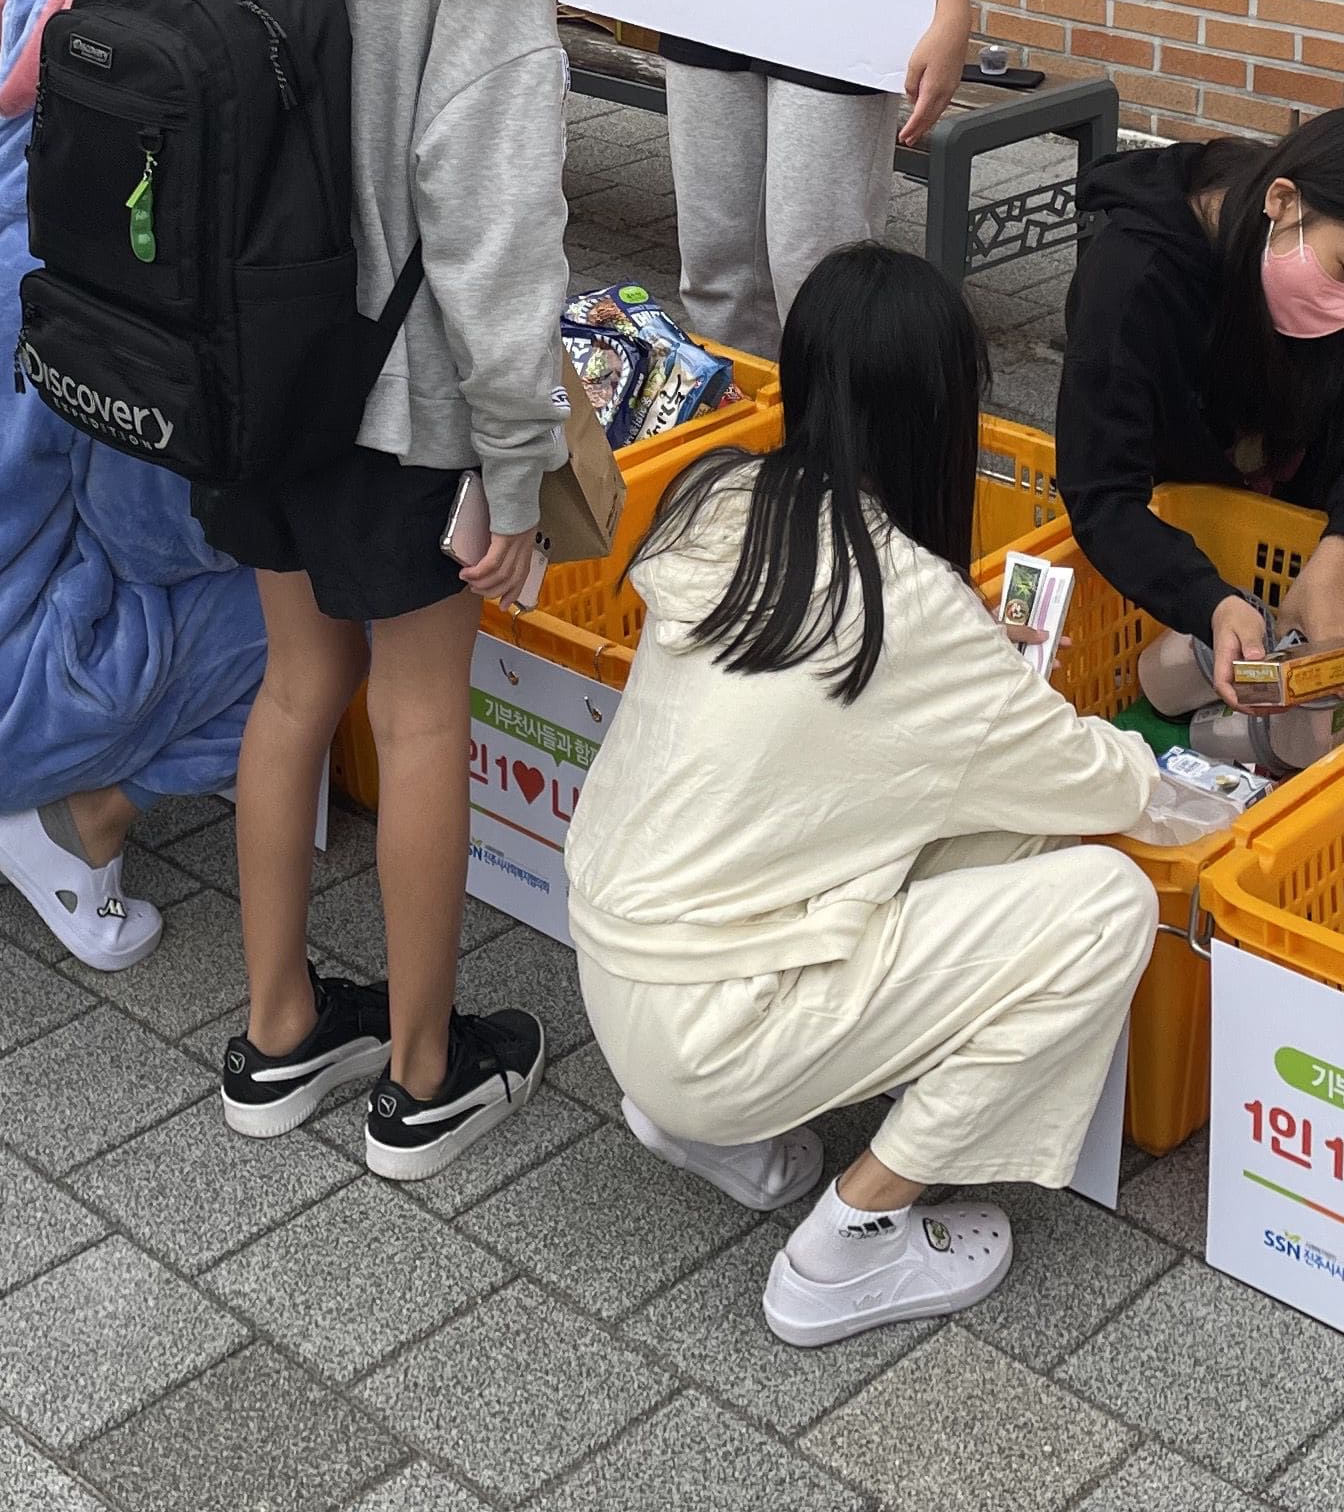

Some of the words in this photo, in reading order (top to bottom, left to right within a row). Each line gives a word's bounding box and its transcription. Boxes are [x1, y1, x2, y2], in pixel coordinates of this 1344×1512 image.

[484, 699, 572, 757] 기부천사들과
[1244, 1100, 1312, 1169] 1인
[1264, 1229, 1300, 1261] SSN
